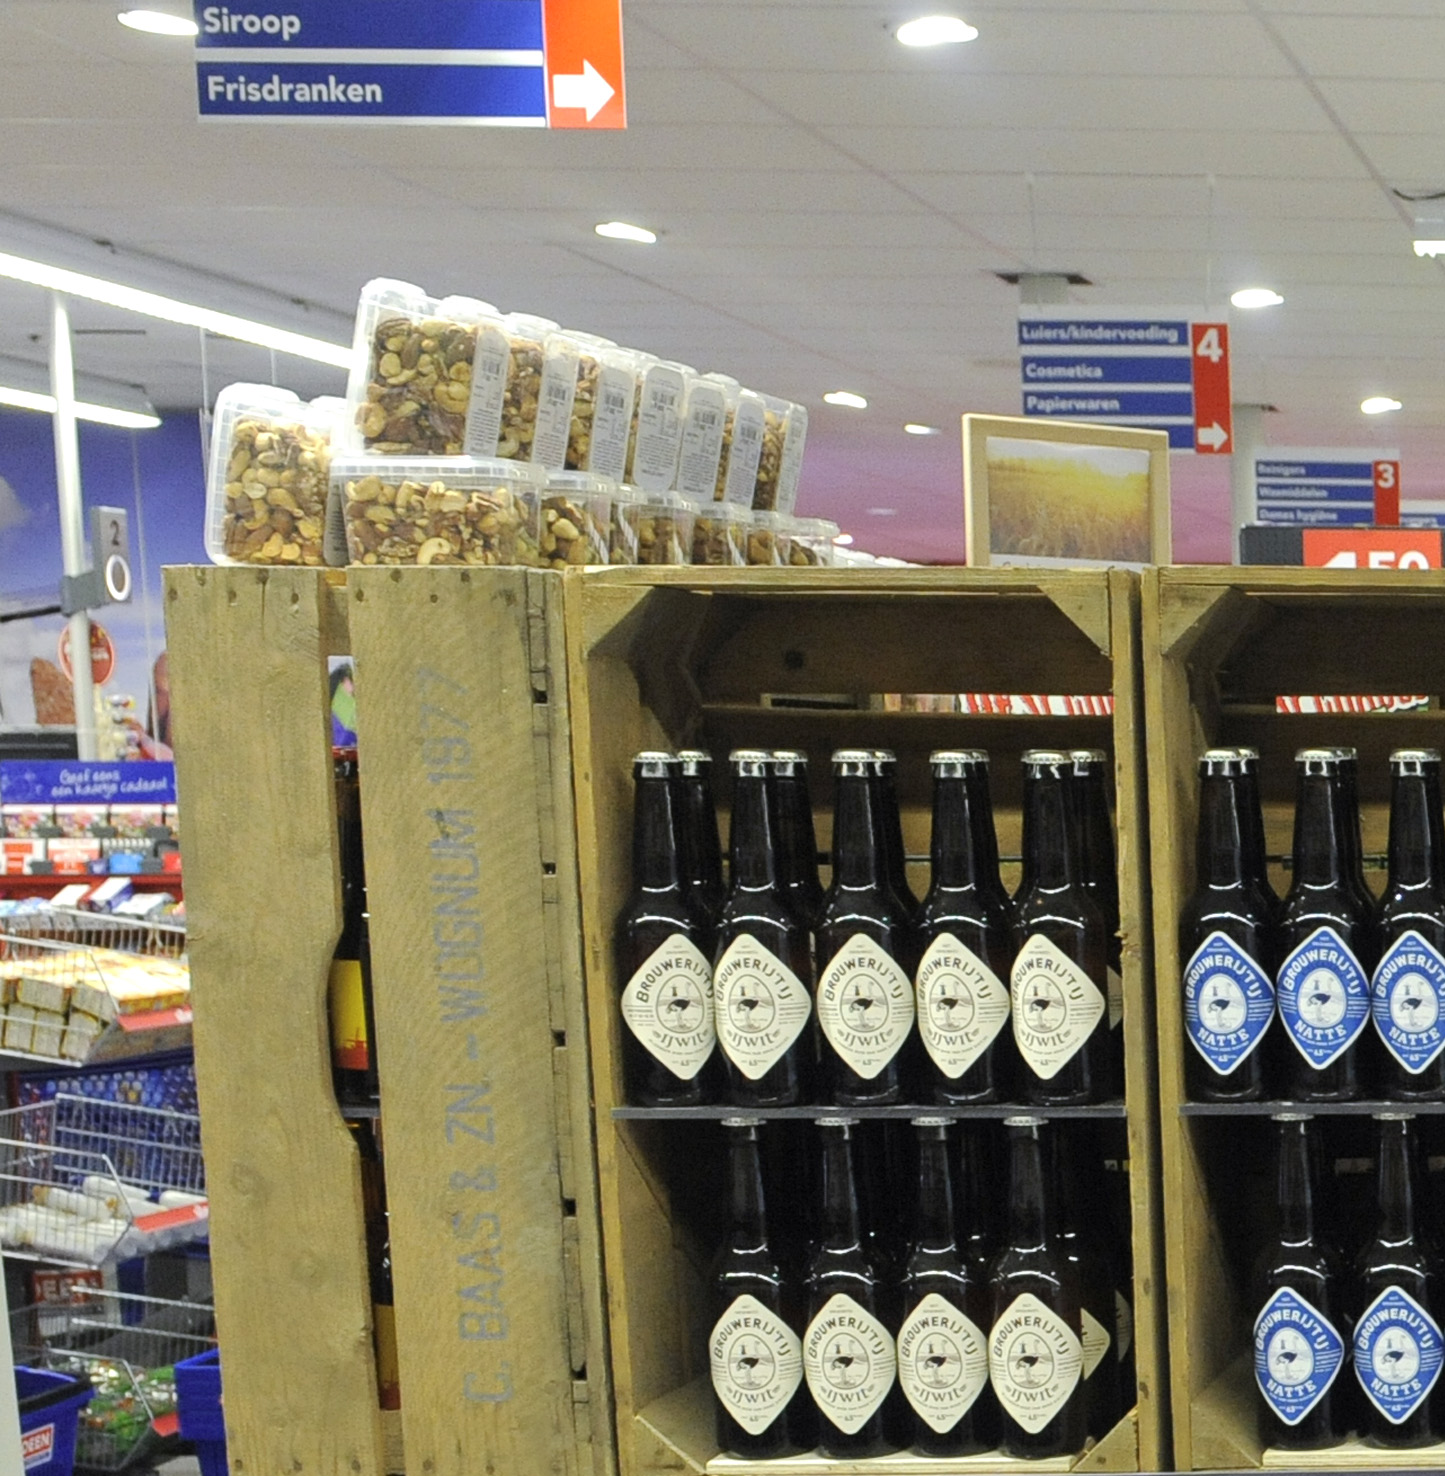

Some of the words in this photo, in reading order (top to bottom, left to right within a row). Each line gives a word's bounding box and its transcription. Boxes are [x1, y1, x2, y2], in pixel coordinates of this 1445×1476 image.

[204, 7, 301, 40] Siroop
[207, 76, 383, 104] Frisdranken
[1197, 328, 1223, 363] 4
[1025, 363, 1103, 378] Cosmetica
[1027, 396, 1120, 412] Papierwaren
[1378, 463, 1394, 488] 3
[110, 521, 121, 544] 2
[415, 666, 473, 785] 1977
[424, 808, 488, 1021] WOGNUM
[1389, 1028, 1440, 1047] NATTE
[450, 1211, 511, 1340] BAAS
